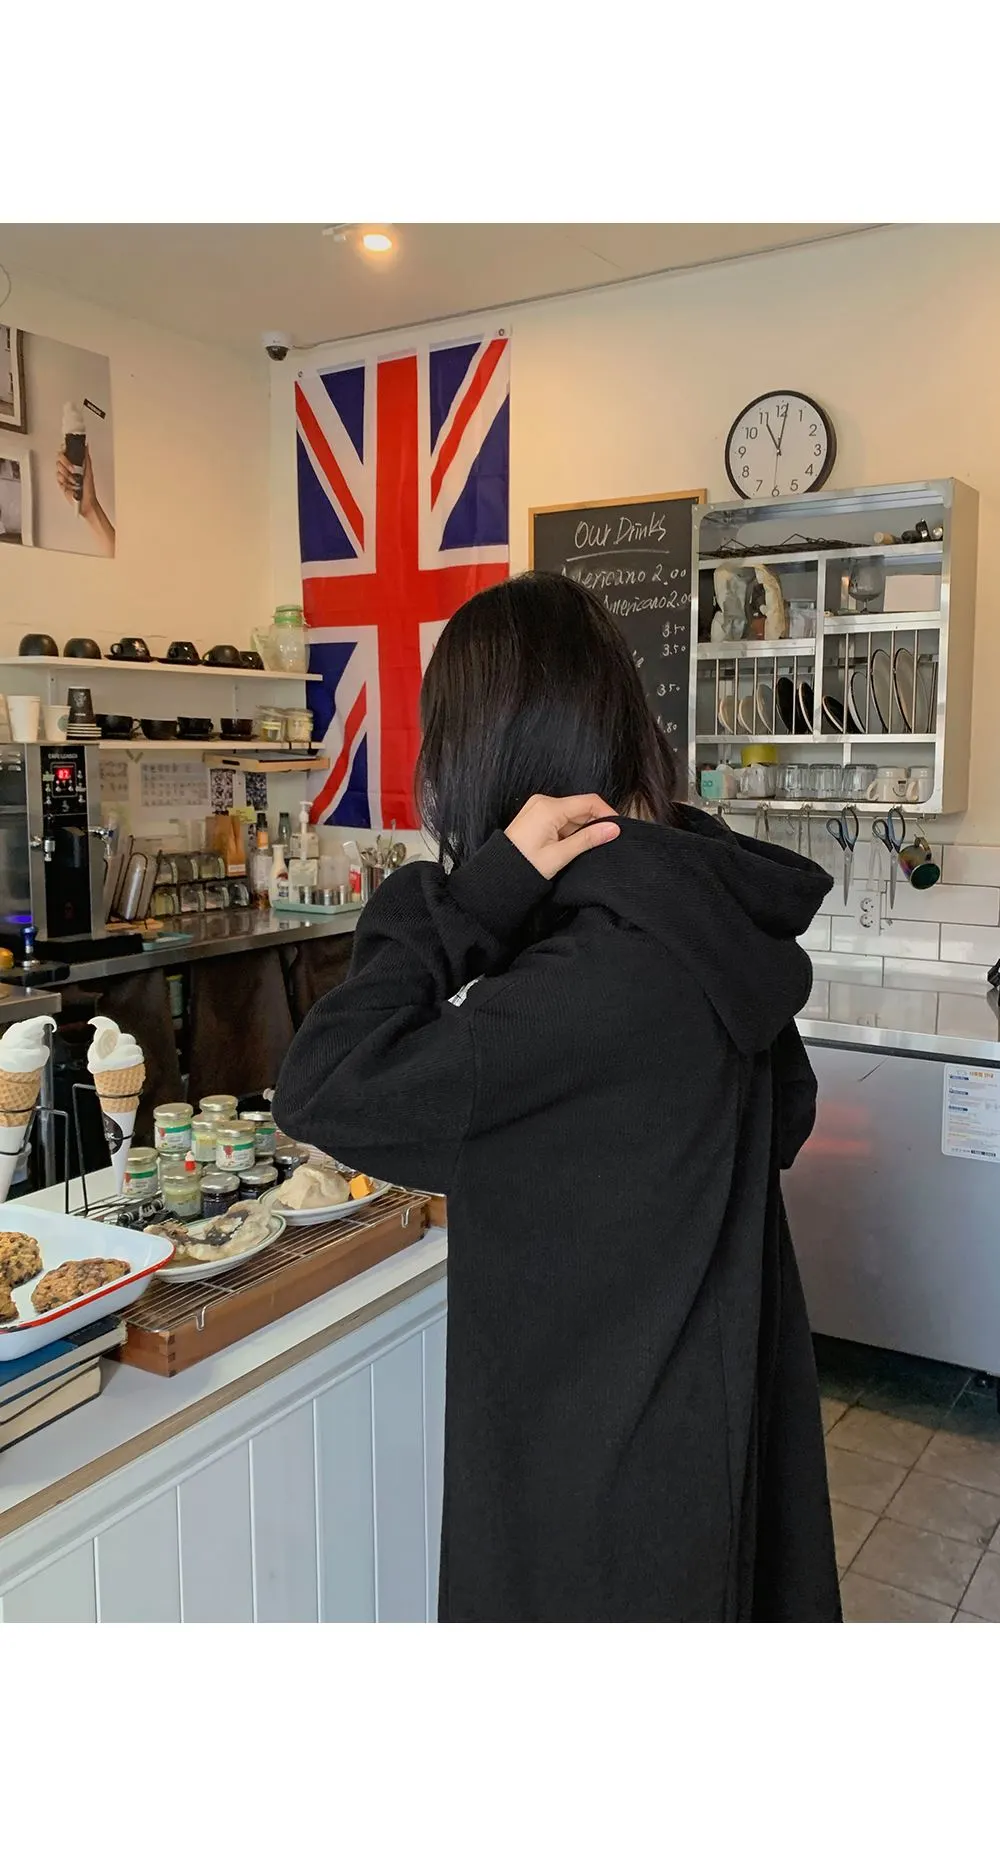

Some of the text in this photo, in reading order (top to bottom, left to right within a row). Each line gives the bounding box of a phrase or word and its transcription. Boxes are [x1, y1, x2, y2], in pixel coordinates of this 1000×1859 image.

[759, 411, 769, 425] 11
[776, 404, 788, 418] 12
[745, 427, 758, 440] 10
[808, 424, 818, 437] 2
[738, 446, 747, 459] 9
[813, 443, 822, 457] 3
[741, 465, 750, 479] 8
[804, 463, 814, 477] 4
[756, 479, 763, 492] 7
[771, 485, 780, 498] 6
[790, 479, 799, 492] 5
[574, 511, 667, 549] Our Drinks
[651, 563, 687, 586] 2.00
[662, 643, 686, 657] 3.50
